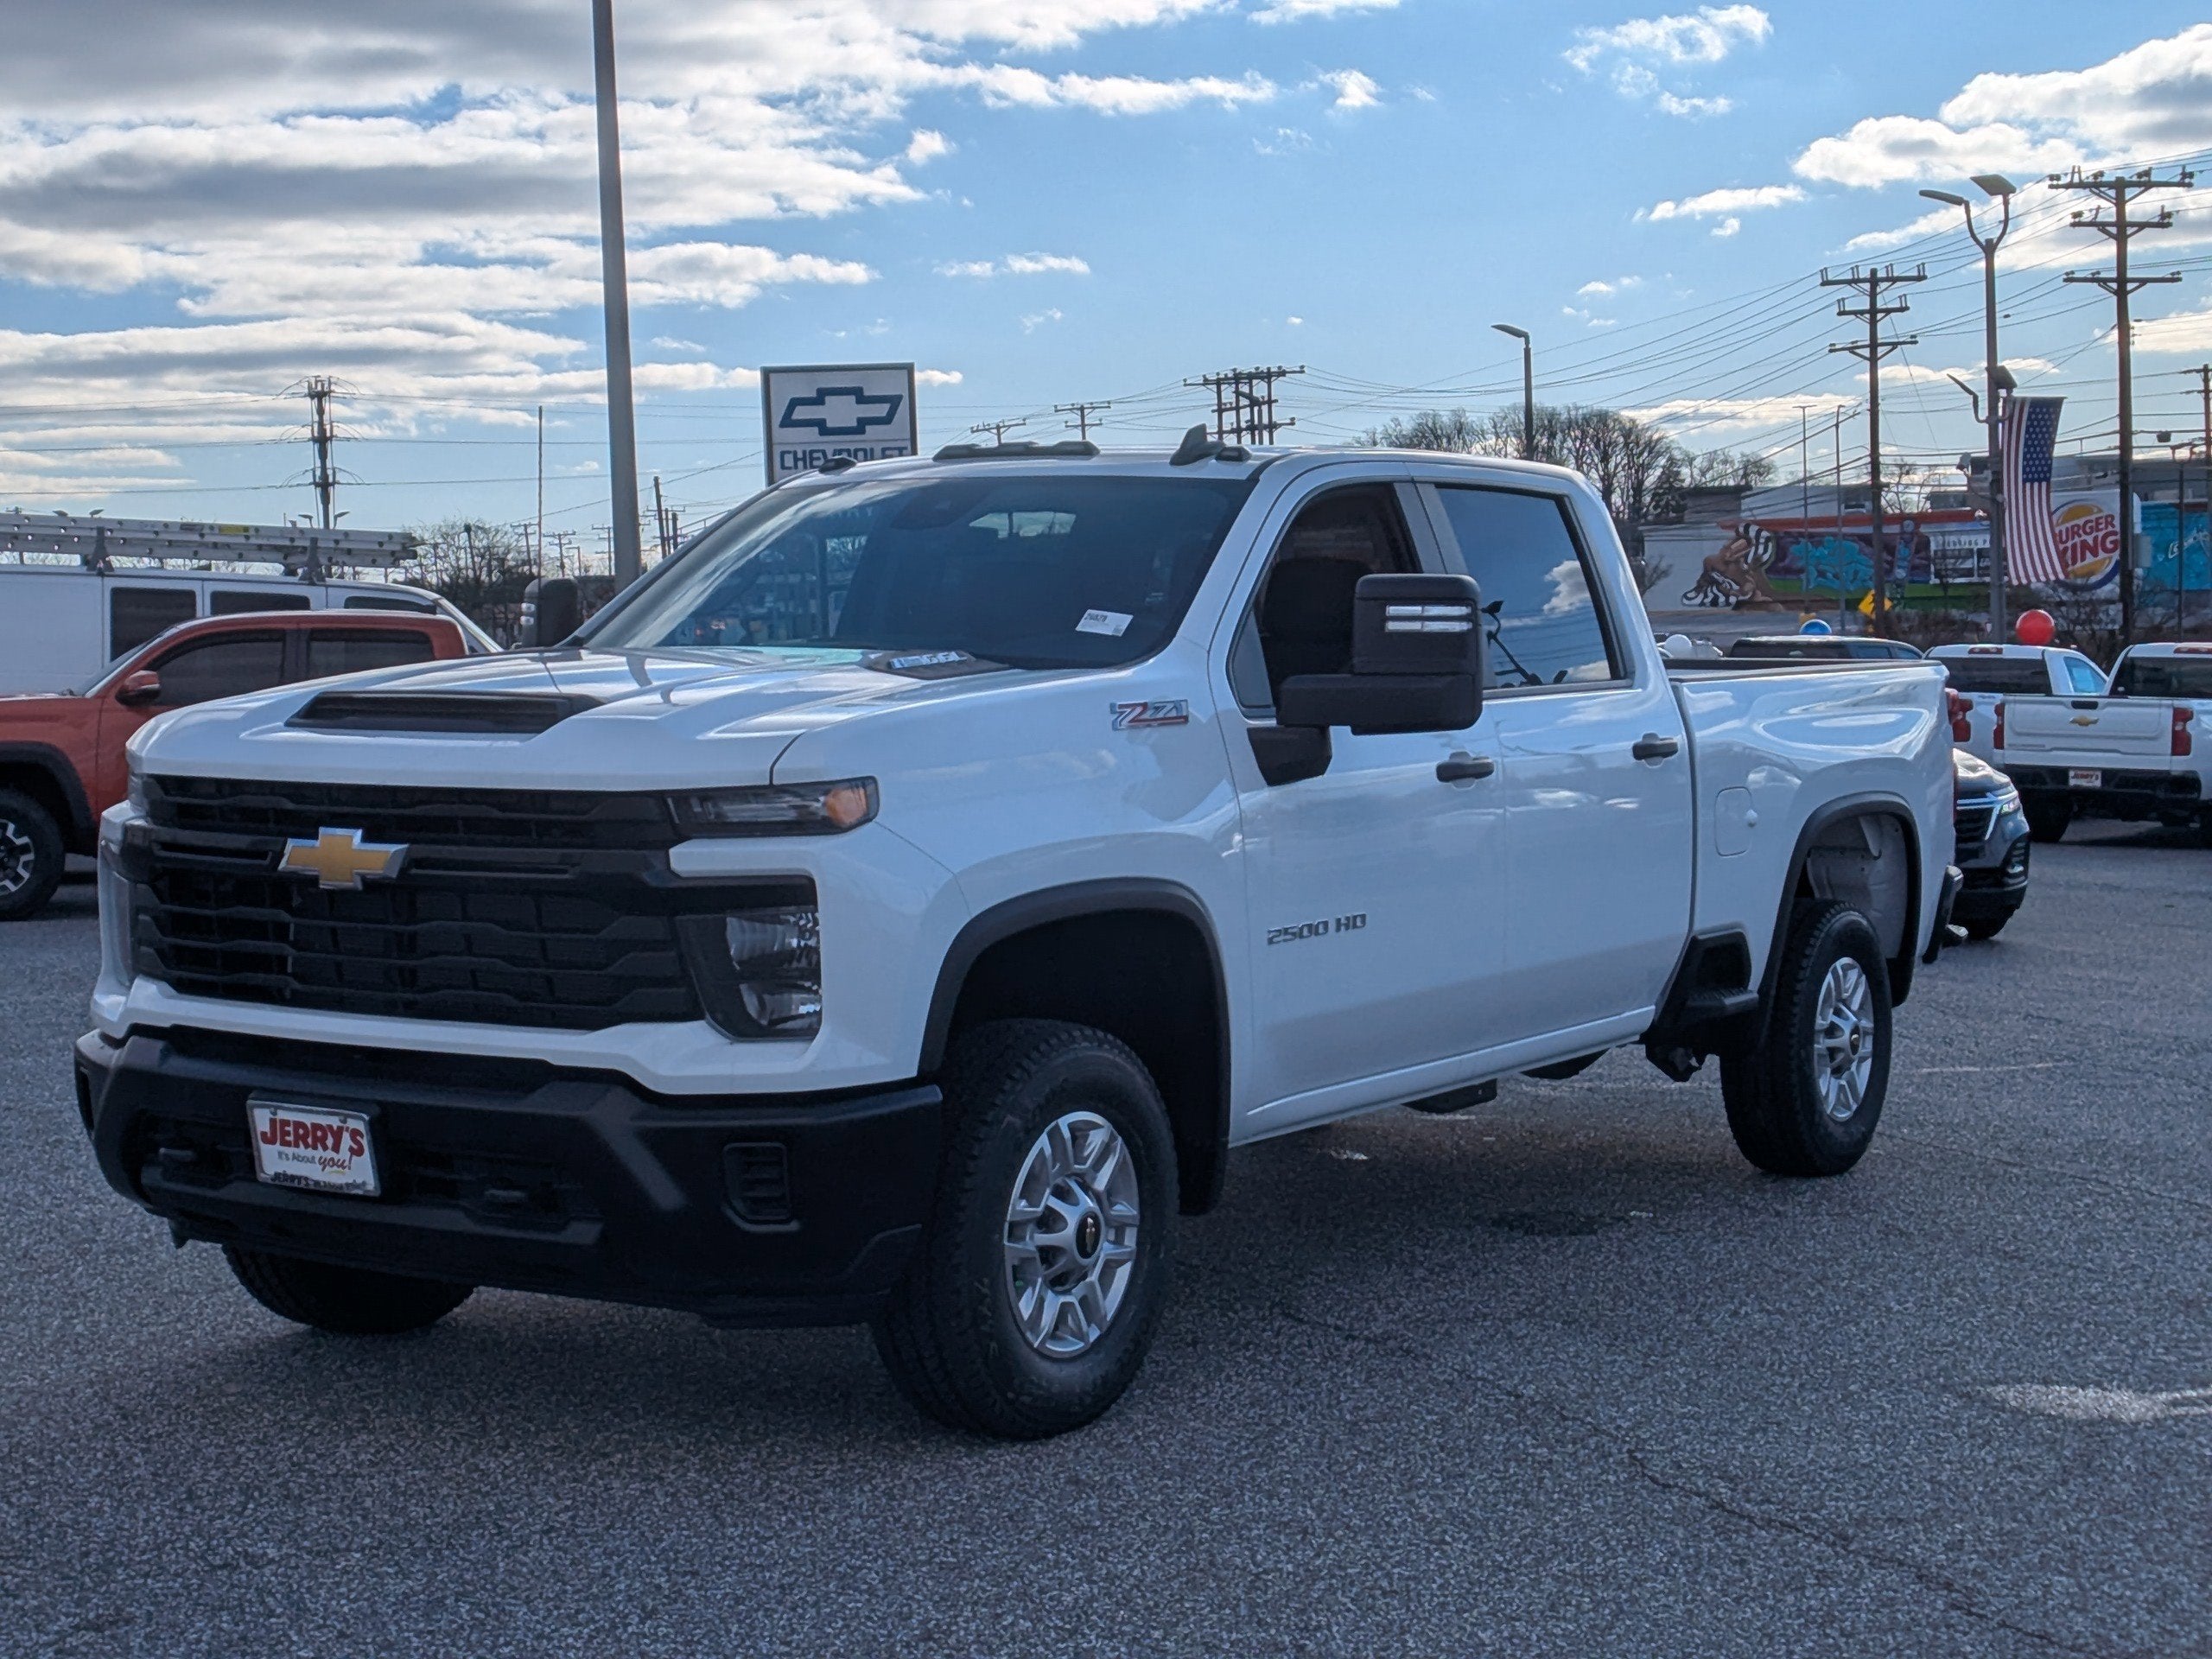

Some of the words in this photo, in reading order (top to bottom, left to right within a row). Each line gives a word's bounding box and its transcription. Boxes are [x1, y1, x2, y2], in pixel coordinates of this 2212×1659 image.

[2054, 514, 2115, 545] URGER
[1109, 698, 1189, 732] Z71
[1267, 920, 1329, 945] 2500
[1335, 913, 1367, 932] HD
[260, 1117, 365, 1158] JERRY'S
